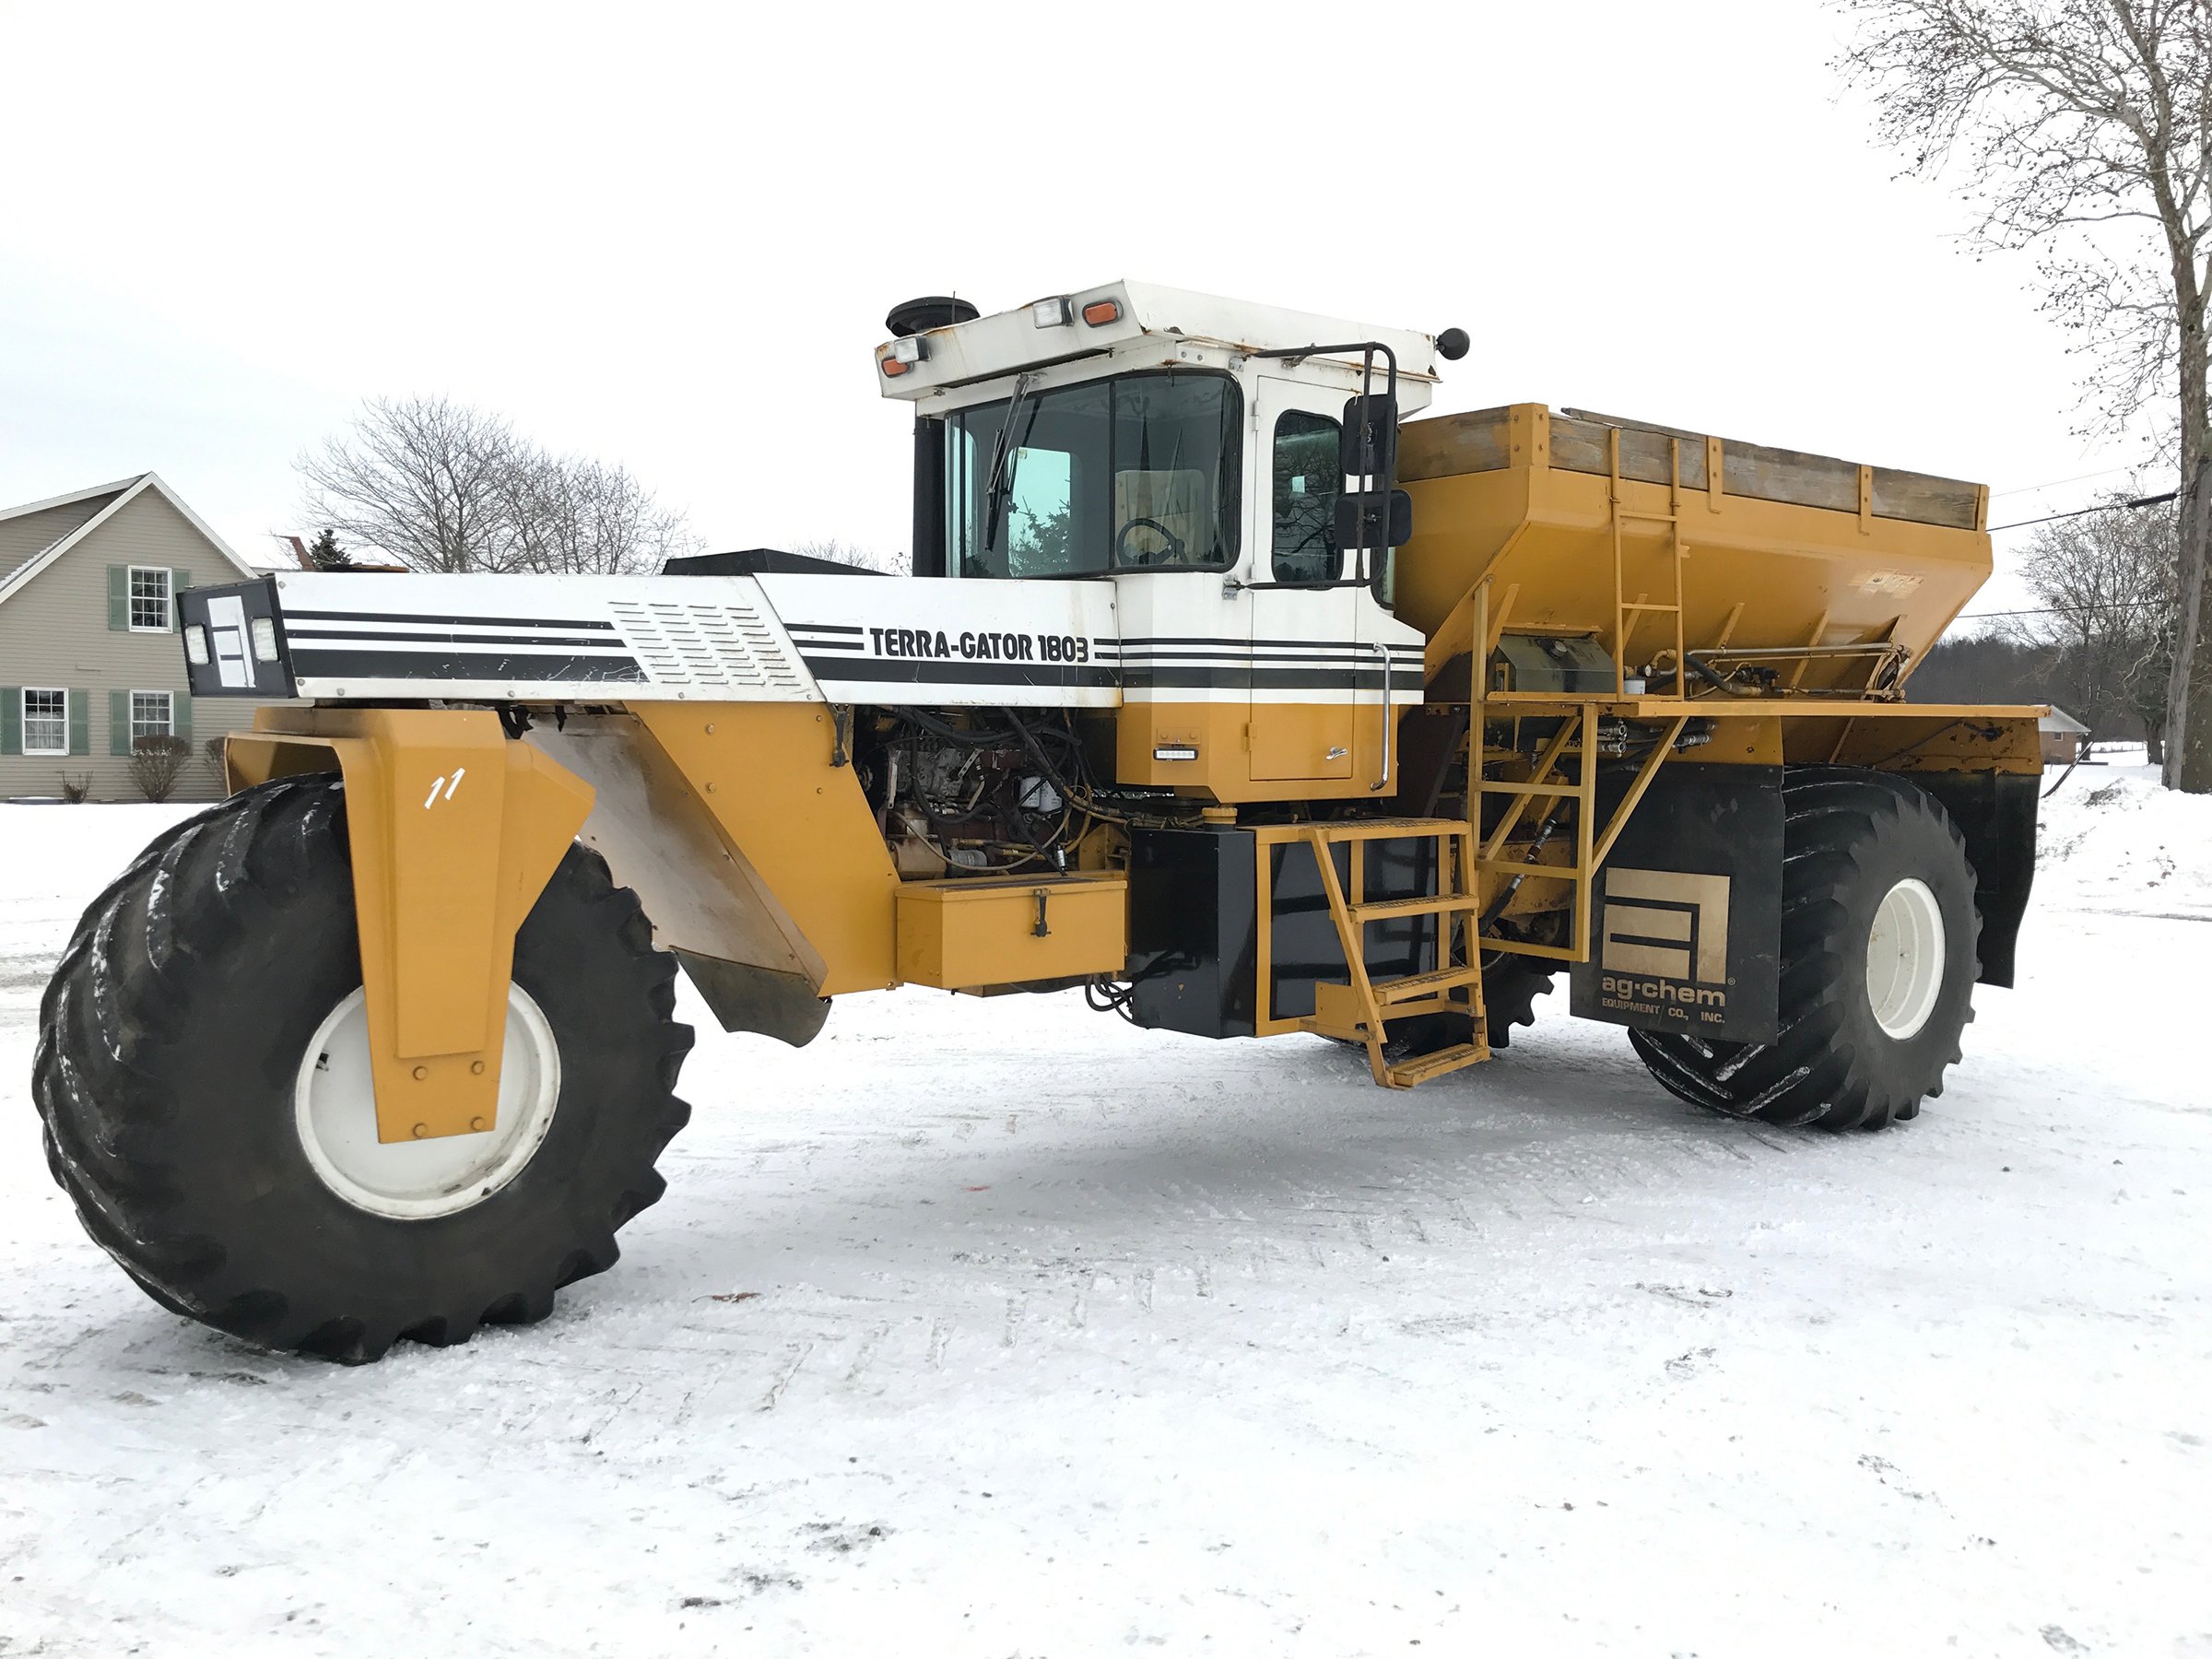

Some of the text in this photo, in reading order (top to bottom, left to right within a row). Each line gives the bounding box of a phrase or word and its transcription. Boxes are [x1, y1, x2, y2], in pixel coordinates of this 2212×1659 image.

[869, 628, 1088, 663] TERRA-GATOR 1803
[1602, 997, 1660, 1015] EQUIPMENT
[1700, 1011, 1725, 1024] INC.
